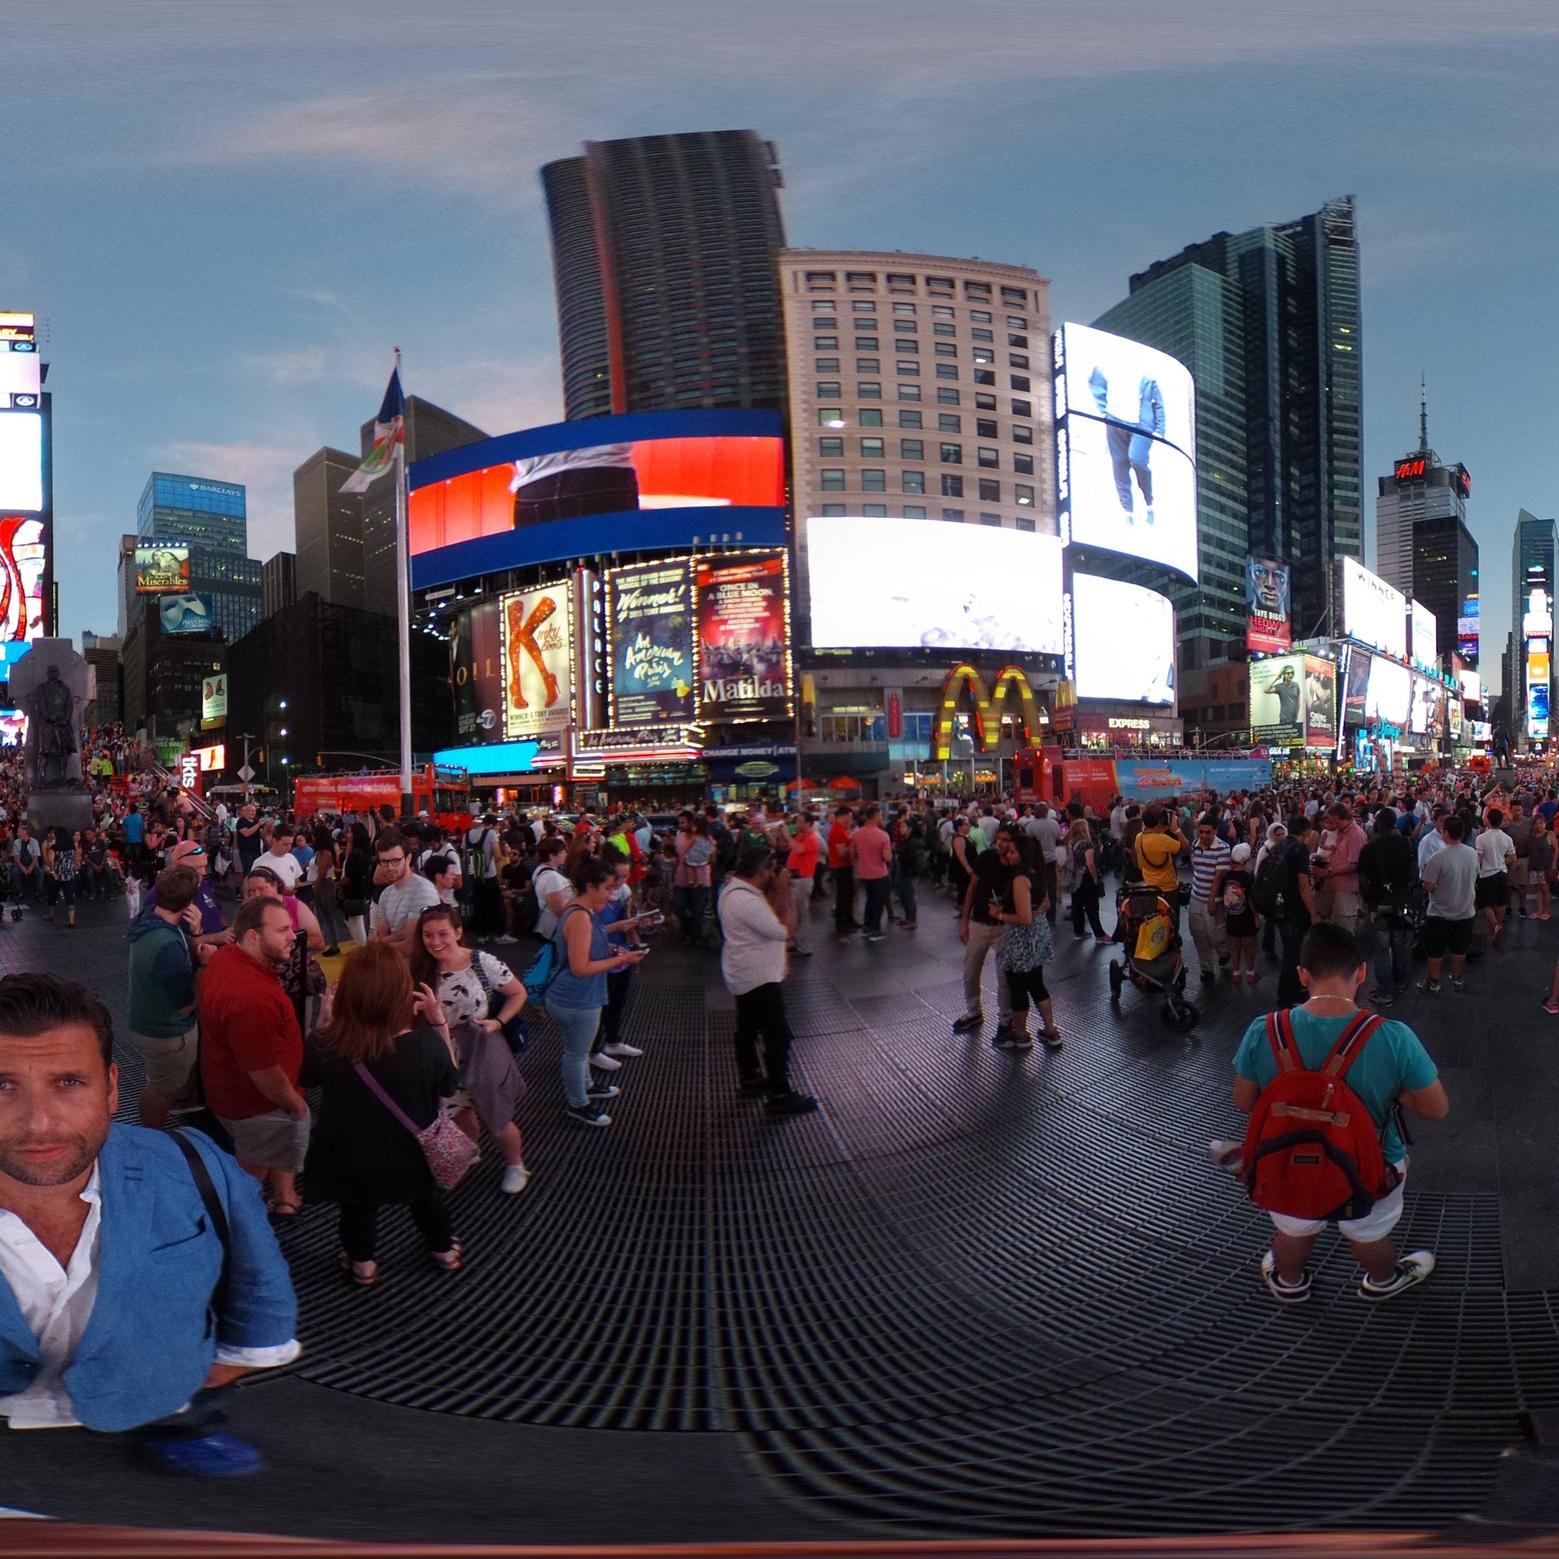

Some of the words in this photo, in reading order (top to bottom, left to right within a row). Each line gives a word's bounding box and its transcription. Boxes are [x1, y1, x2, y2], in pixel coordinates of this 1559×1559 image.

[200, 484, 241, 497] BARCLAYS
[703, 675, 785, 703] Matilda
[1108, 718, 1151, 730] EXPRESS
[182, 756, 198, 788] tkts
